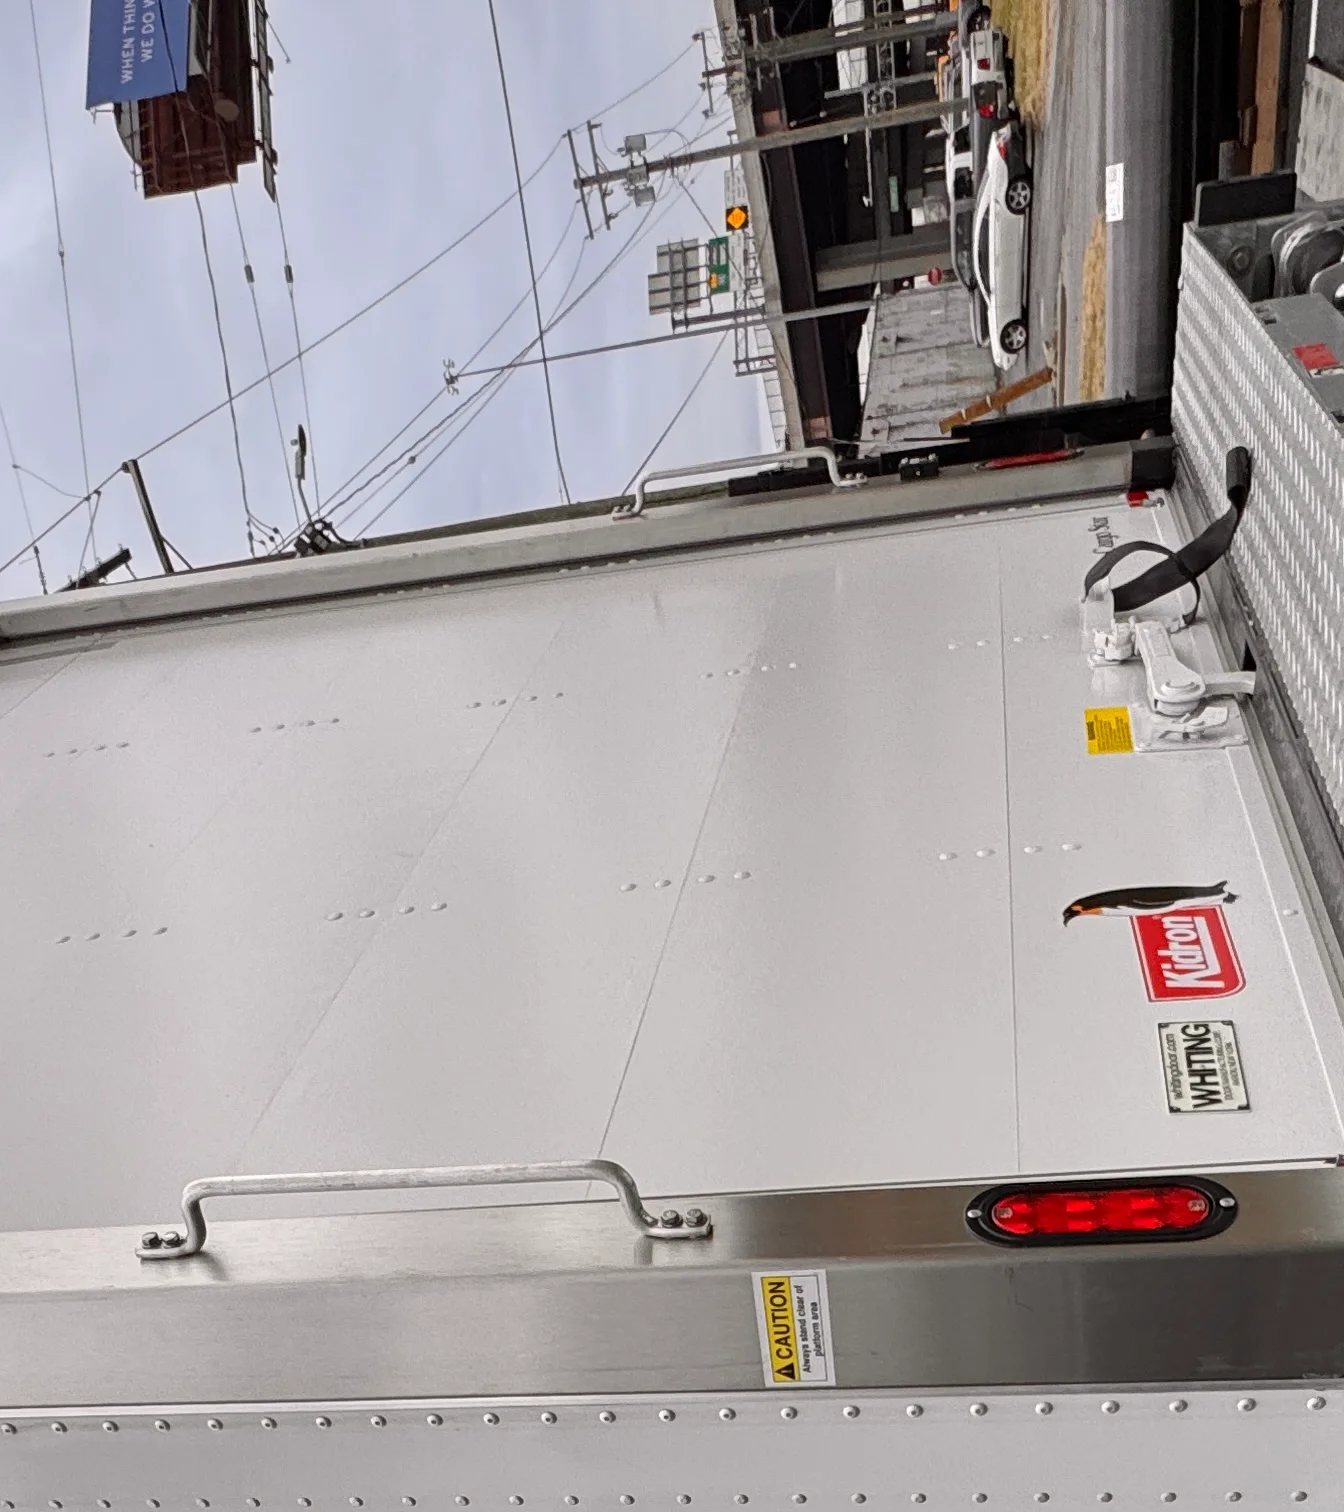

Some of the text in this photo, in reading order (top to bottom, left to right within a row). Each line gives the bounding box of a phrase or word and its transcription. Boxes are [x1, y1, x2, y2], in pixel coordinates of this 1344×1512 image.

[141, 12, 155, 34] DO
[141, 38, 154, 62] WE
[121, 37, 135, 84] WHEN
[1158, 917, 1225, 988] Kidron
[1181, 1024, 1222, 1109] WHITING
[768, 1282, 793, 1359] CAUTION
[794, 1285, 811, 1373] Always stand clear of
[810, 1302, 823, 1356] platform area
